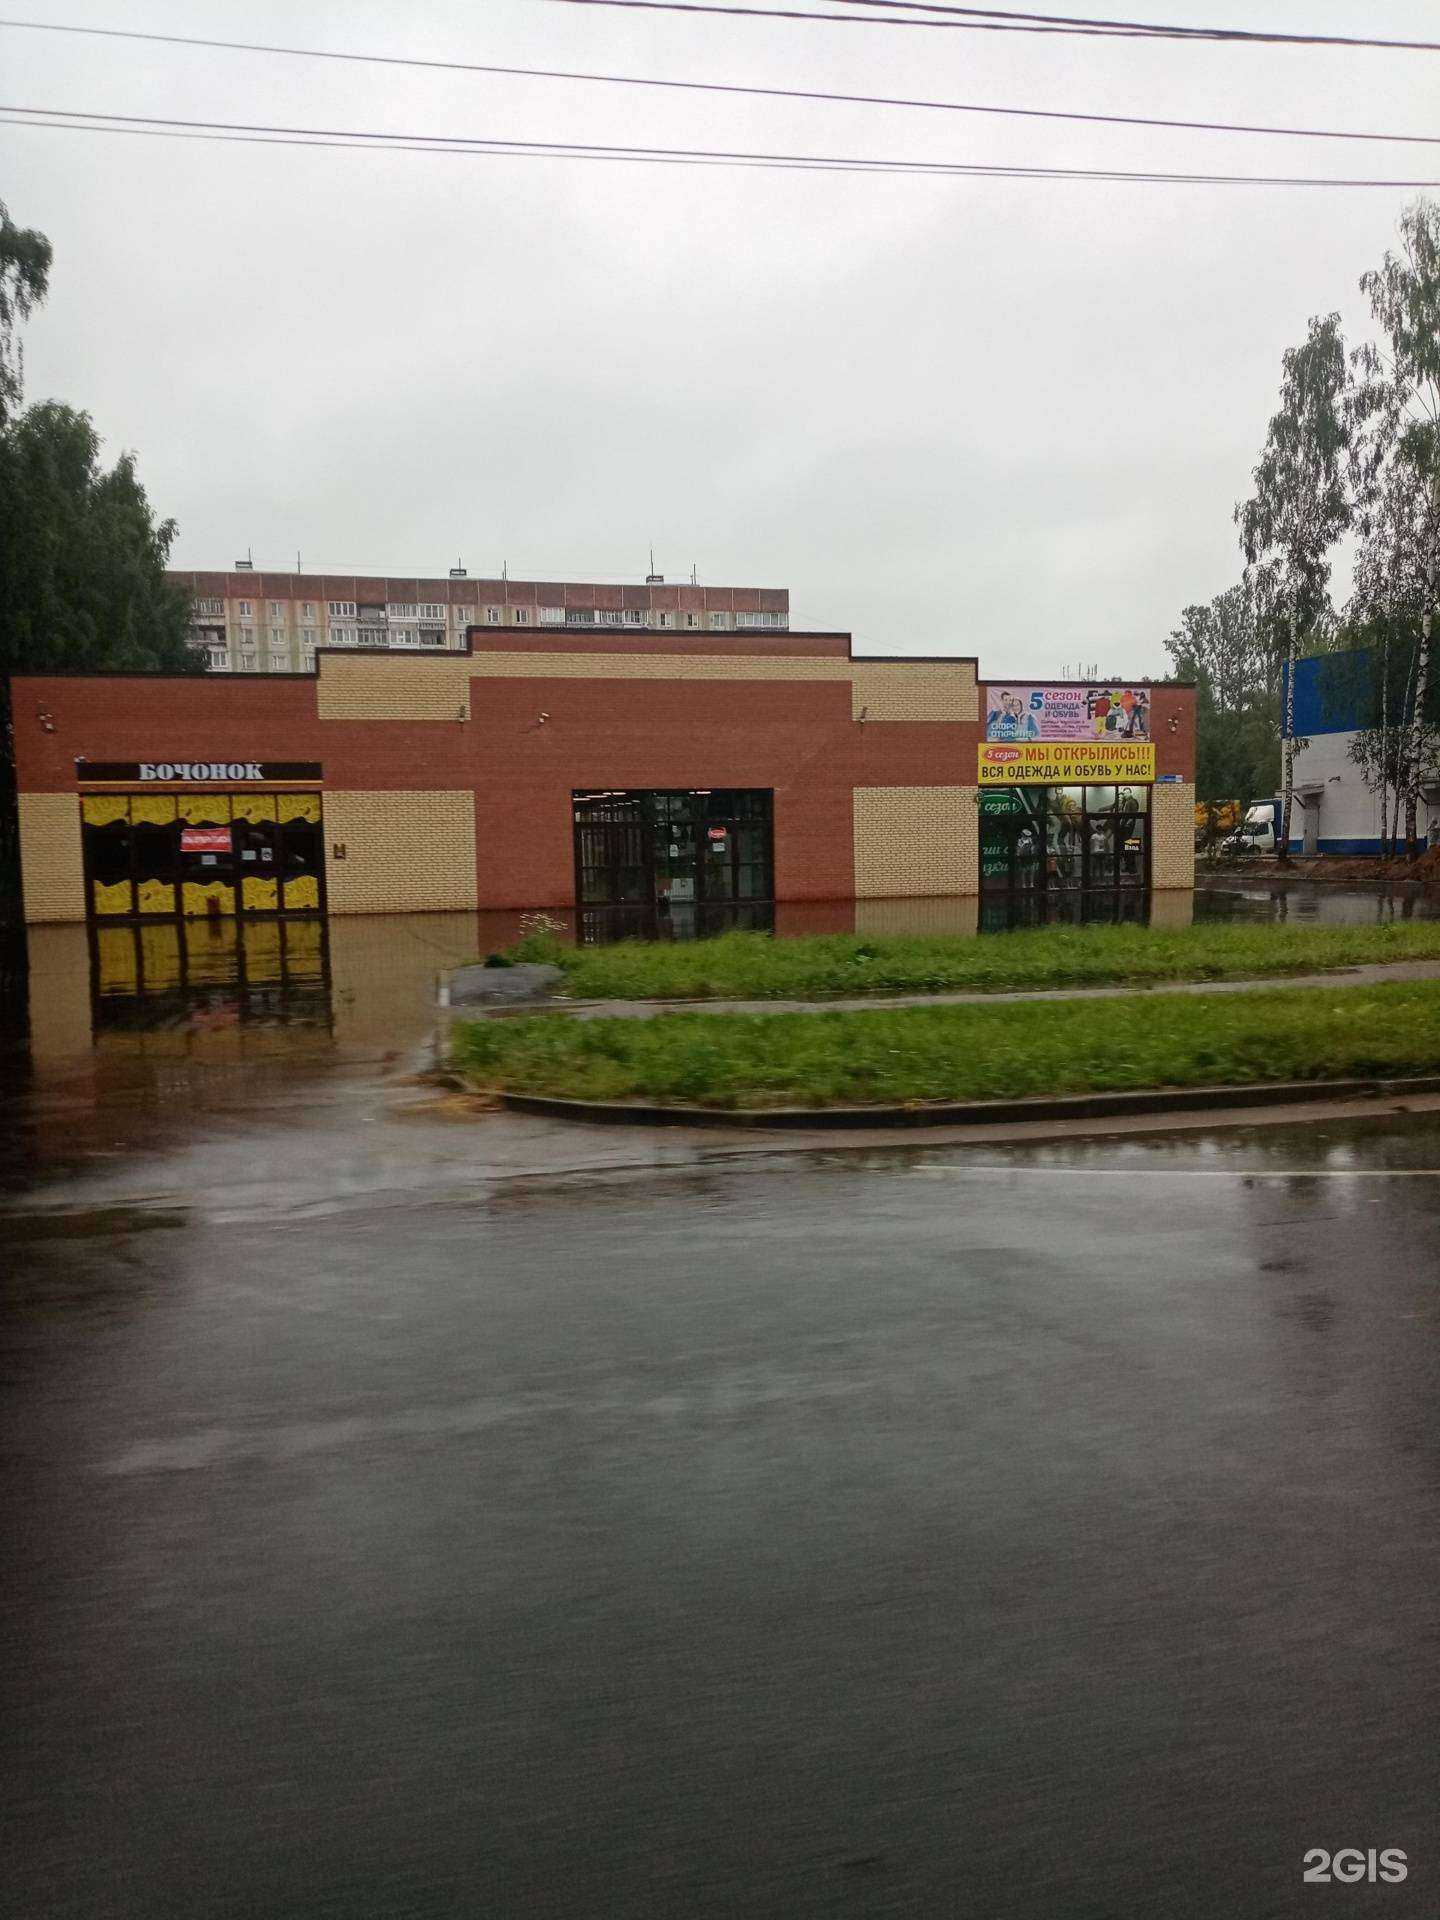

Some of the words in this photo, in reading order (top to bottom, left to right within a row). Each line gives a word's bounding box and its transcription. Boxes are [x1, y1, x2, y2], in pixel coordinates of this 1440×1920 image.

[1029, 692, 1043, 710] 5
[1045, 692, 1081, 701] сезон
[1045, 702, 1080, 710] ОДЕЖДА
[1052, 710, 1080, 718] ОБУВЬ
[987, 750, 993, 759] 5
[994, 751, 1020, 761] сезон
[1025, 748, 1049, 761] МЫ
[1054, 746, 1150, 761] ОТКРЫЛИСЬ!!!
[139, 764, 264, 780] БОЧОНОК
[982, 766, 1004, 778] ВСЯ
[1008, 765, 1060, 780] ОДЕЖДА
[1063, 765, 1071, 777] И
[1074, 764, 1112, 777] ОБУВЬ
[1115, 764, 1123, 776] У
[1126, 763, 1151, 777] НАС!
